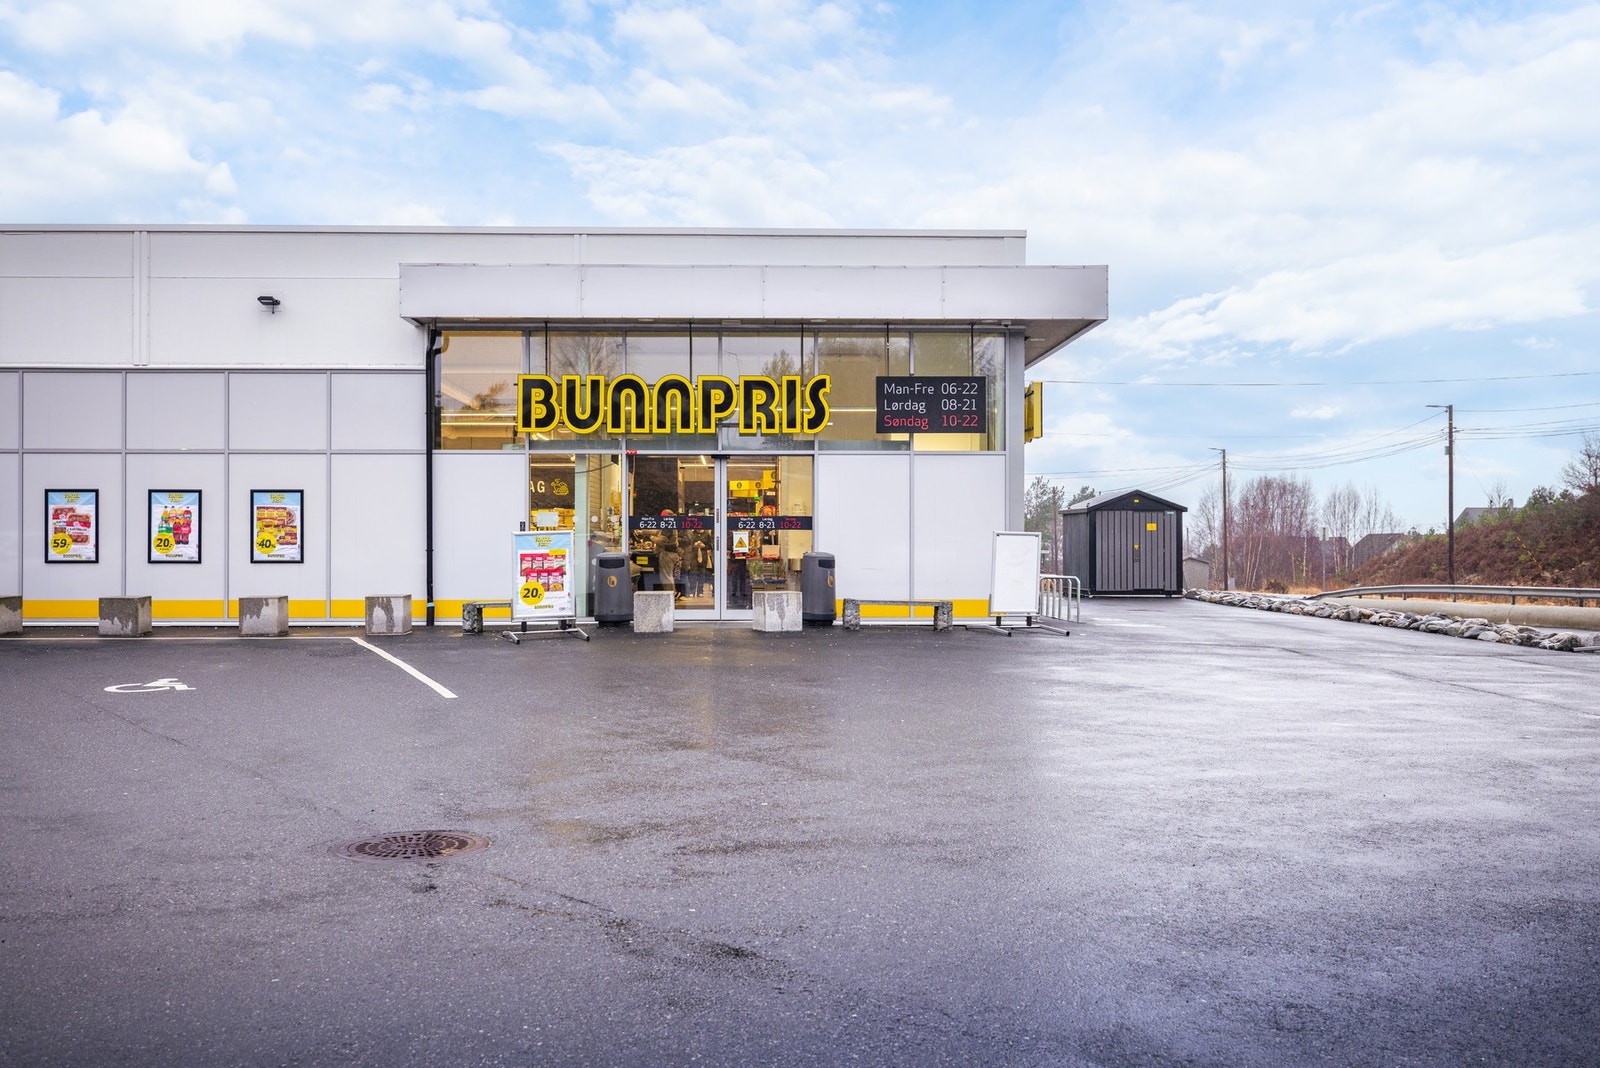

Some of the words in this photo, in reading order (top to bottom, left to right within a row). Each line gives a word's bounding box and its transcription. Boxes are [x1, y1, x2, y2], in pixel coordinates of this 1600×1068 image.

[884, 383, 935, 395] Man-Fre
[941, 383, 978, 395] 06-22
[517, 373, 831, 434] BUNNPRIS
[884, 399, 926, 413] Lørdag
[941, 399, 977, 411] 08-21
[884, 415, 929, 430] Søndag
[942, 415, 978, 427] 10-22
[738, 521, 755, 529] 6-22
[758, 521, 775, 529] 8-21
[523, 588, 542, 599] 20,-
